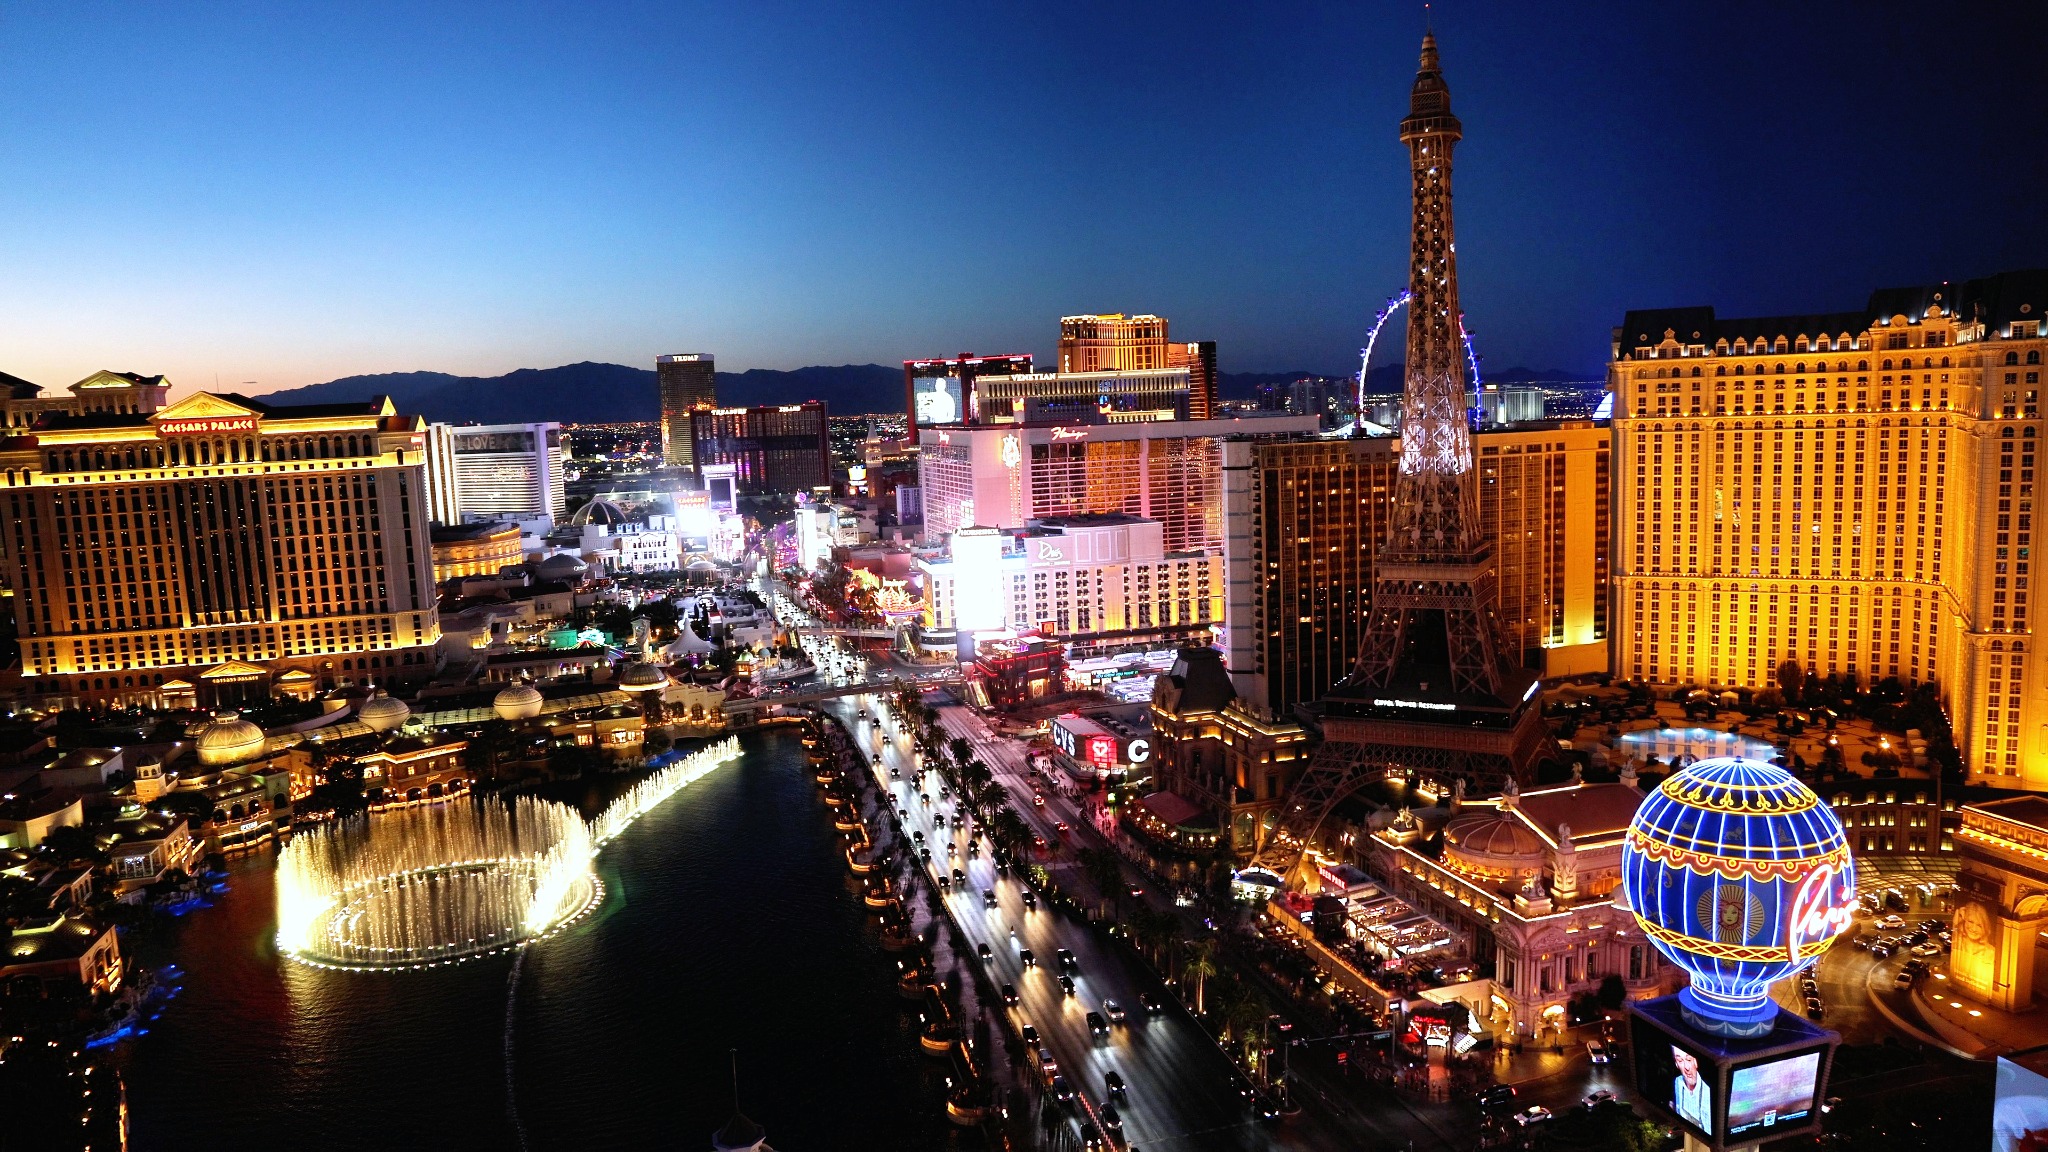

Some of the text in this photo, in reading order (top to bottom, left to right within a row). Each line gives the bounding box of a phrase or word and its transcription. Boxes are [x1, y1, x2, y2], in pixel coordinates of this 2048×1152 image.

[1011, 372, 1056, 381] VENETIAN
[159, 420, 253, 433] CAESARS PALACE
[467, 436, 497, 451] LOVE
[1053, 723, 1076, 757] CVS
[1128, 739, 1149, 763] C
[1318, 867, 1346, 890] BEER PARK
[1787, 864, 1860, 966] Paris
